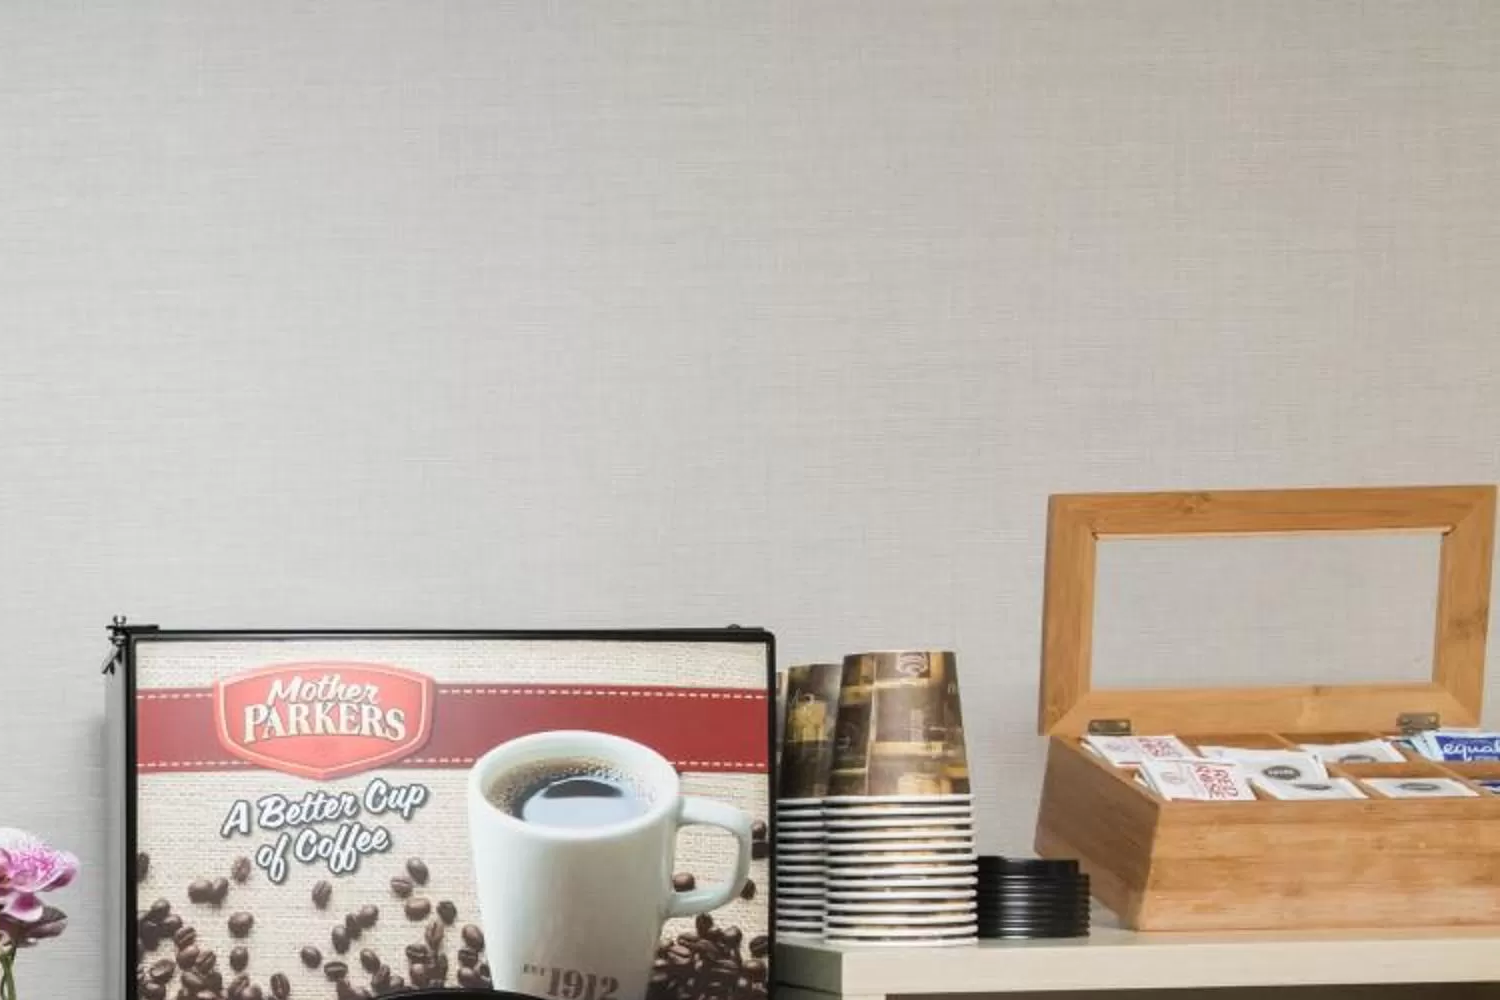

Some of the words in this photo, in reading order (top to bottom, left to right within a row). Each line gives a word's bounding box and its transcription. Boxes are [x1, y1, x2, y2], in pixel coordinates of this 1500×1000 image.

[267, 674, 379, 705] Mother
[243, 702, 406, 743] PARKERS
[221, 800, 250, 838] A
[257, 791, 361, 828] Better
[364, 778, 428, 820] Cup
[256, 832, 290, 884] of
[294, 822, 391, 875] Coffee
